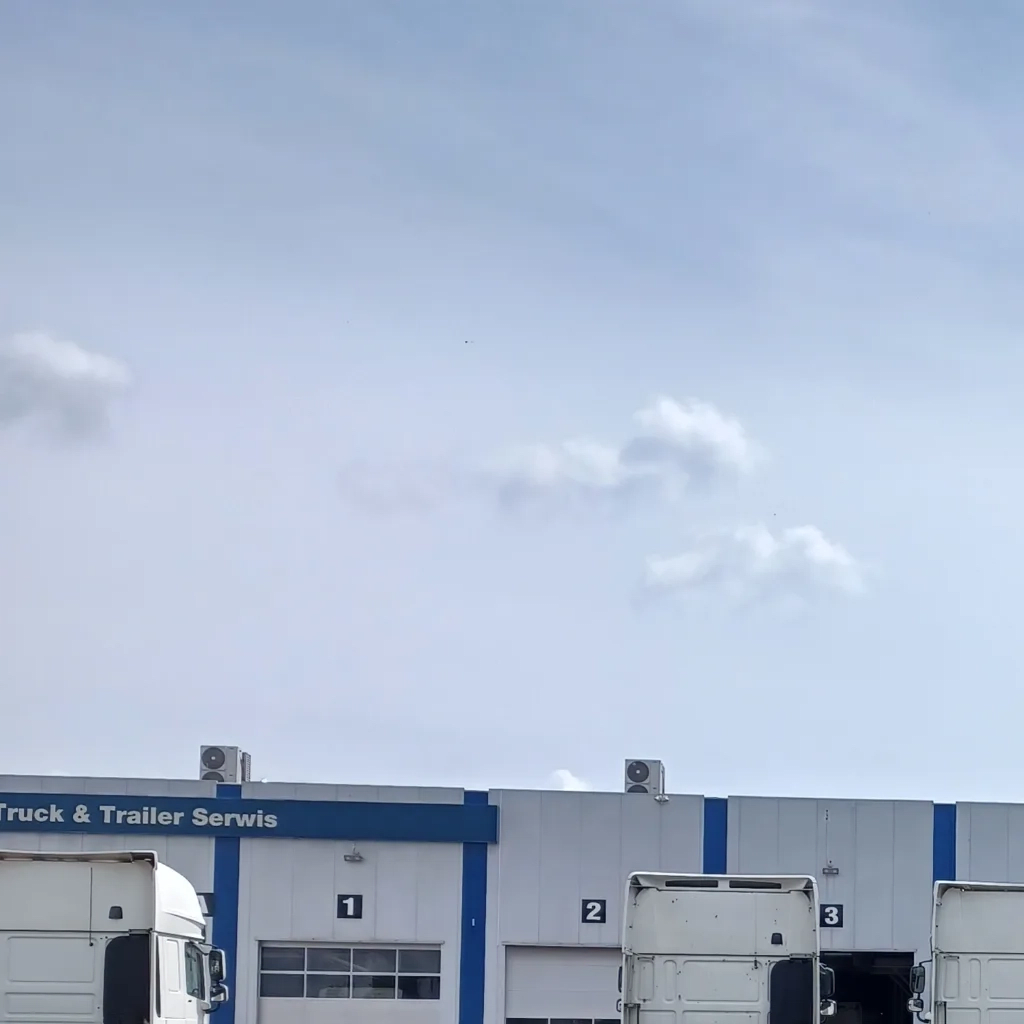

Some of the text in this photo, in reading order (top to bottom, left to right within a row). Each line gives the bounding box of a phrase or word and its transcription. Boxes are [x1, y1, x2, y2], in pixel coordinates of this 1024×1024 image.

[72, 804, 91, 823] &
[100, 805, 184, 825] Trailer
[192, 807, 278, 828] Serwis
[342, 897, 354, 916] 1
[586, 902, 601, 920] 2
[824, 906, 839, 925] 3
